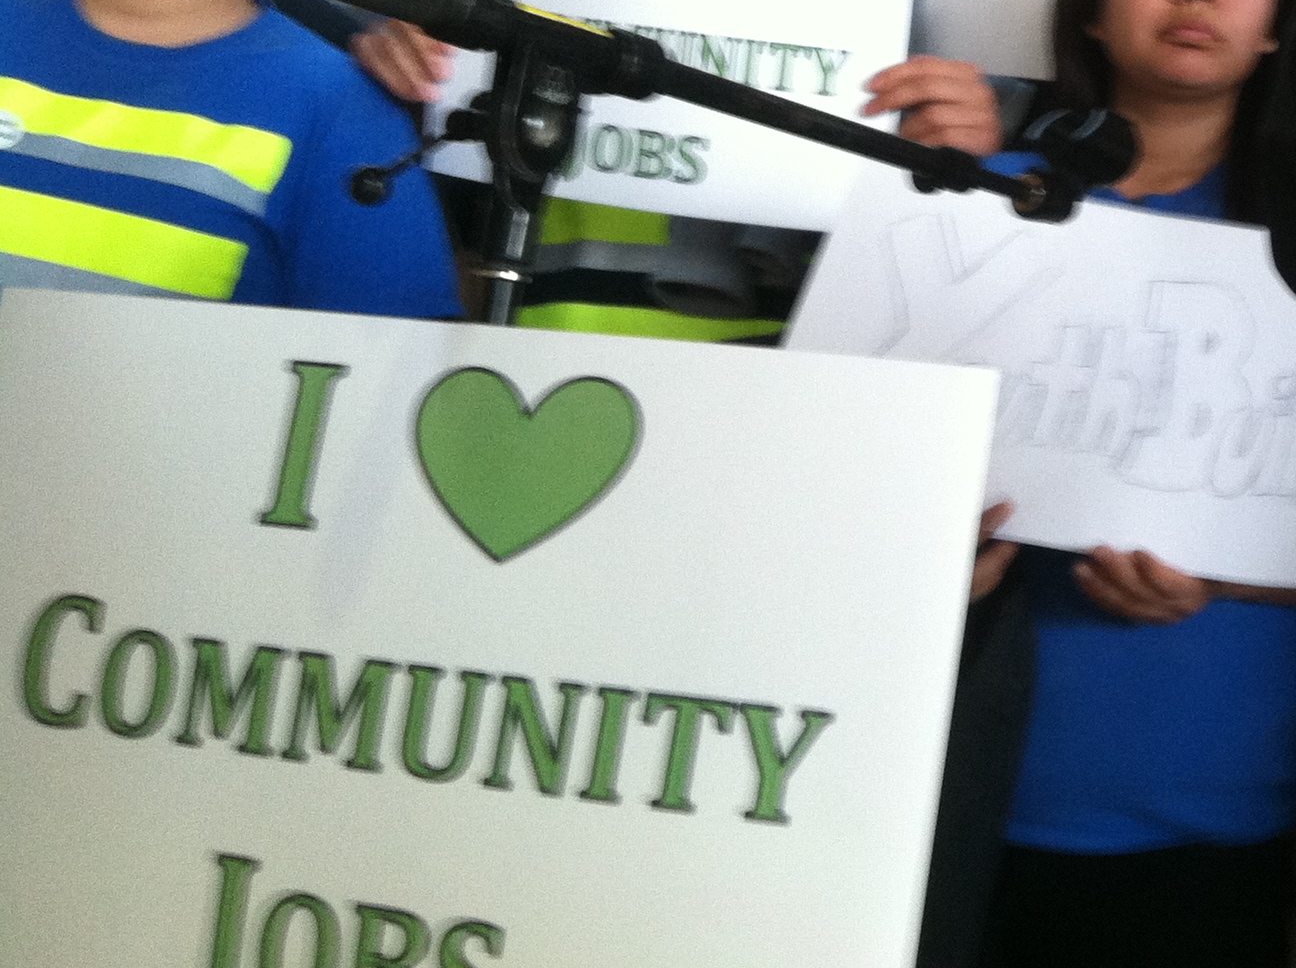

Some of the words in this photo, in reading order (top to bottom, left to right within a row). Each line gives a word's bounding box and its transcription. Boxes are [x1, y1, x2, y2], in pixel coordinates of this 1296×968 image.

[560, 123, 711, 185] OBS
[257, 359, 350, 530] I
[20, 593, 836, 825] COMMUNITY
